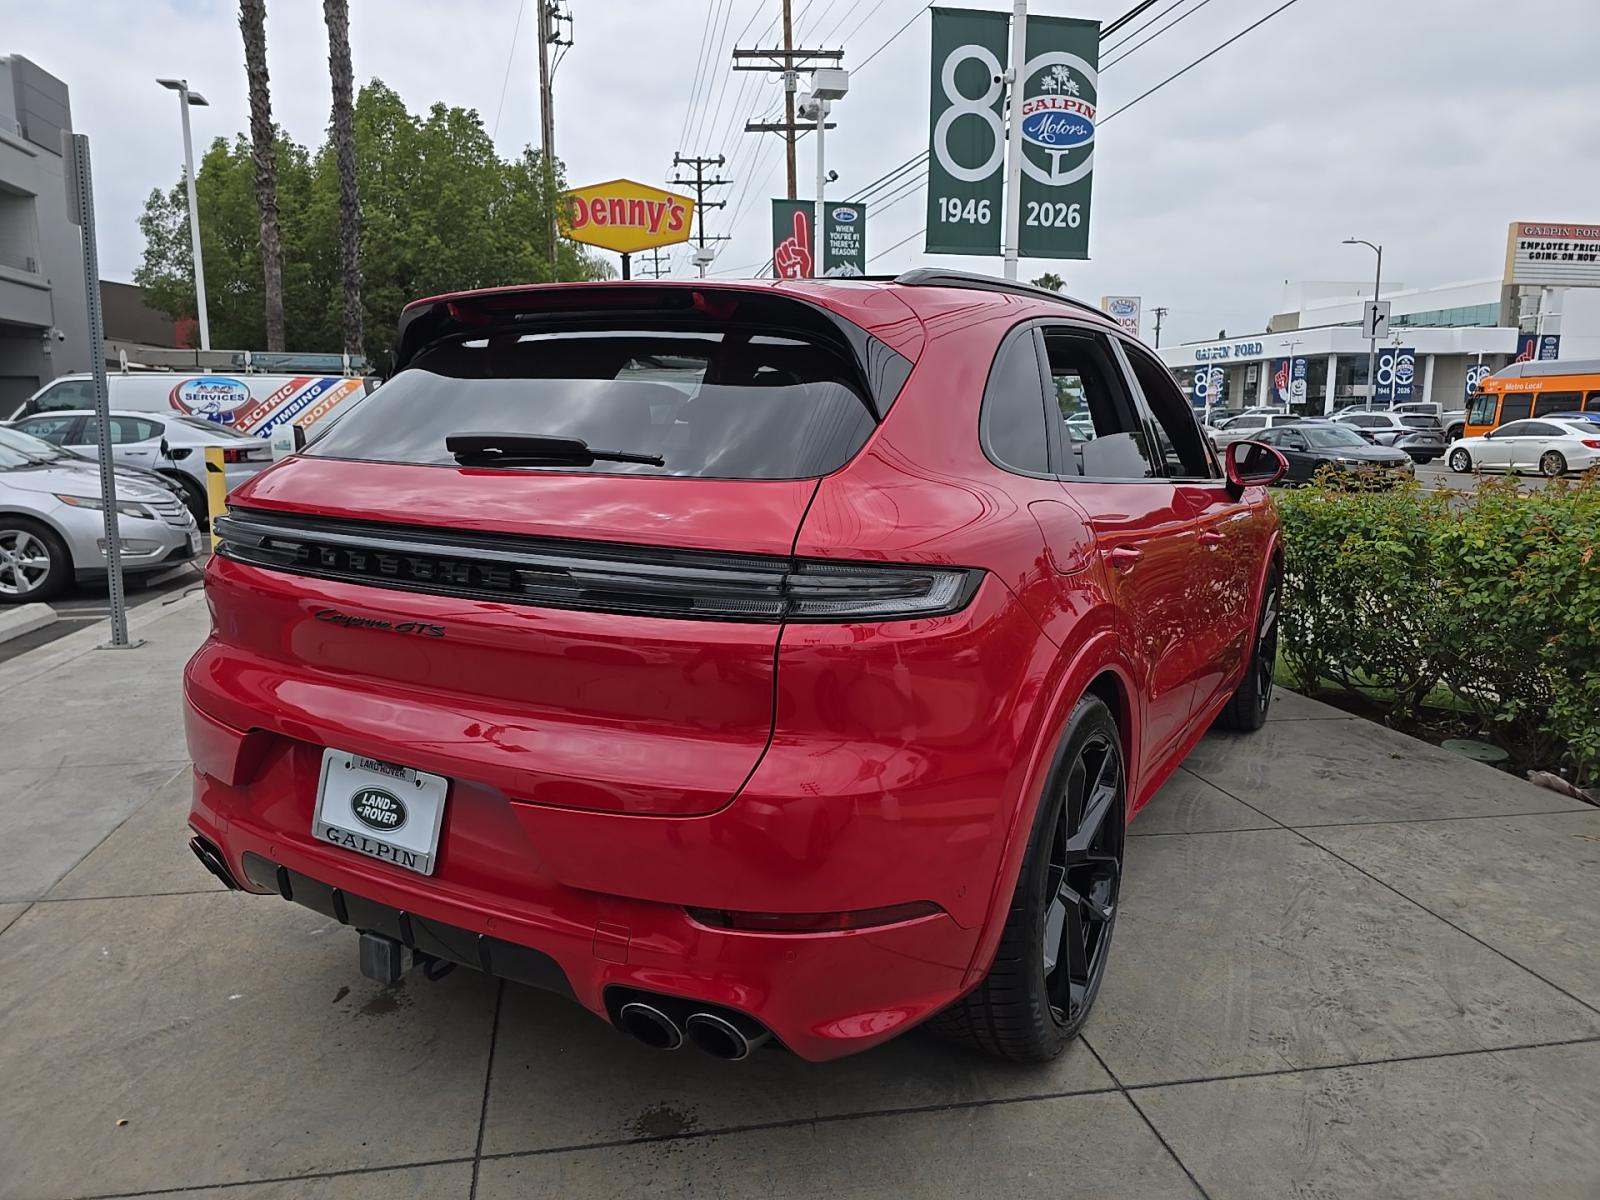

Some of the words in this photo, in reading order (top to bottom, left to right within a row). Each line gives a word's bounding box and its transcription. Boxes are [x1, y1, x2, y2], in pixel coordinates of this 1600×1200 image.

[1022, 98, 1096, 119] GALPIN
[1029, 114, 1087, 143] Motors
[939, 198, 991, 225] 1946
[1026, 202, 1081, 229] 2026
[835, 225, 854, 233] WHEN
[1524, 227, 1570, 236] GALPIN
[1575, 229, 1600, 237] FOR
[1520, 241, 1570, 251] EMPLOYEE
[1573, 243, 1600, 253] PRICI
[1528, 252, 1558, 261] GOING
[1562, 252, 1575, 261] ON
[1577, 253, 1598, 262] NOW
[1234, 342, 1263, 357] FORD
[1504, 383, 1524, 391] Metro
[1524, 381, 1543, 390] Local
[185, 393, 245, 401] SERVICES
[235, 384, 295, 432] LECTRIC
[314, 608, 393, 630] Cayenne
[394, 621, 446, 639] GTS
[361, 792, 391, 810] LAND
[361, 805, 398, 825] ROVER
[326, 827, 418, 868] GALPIN
